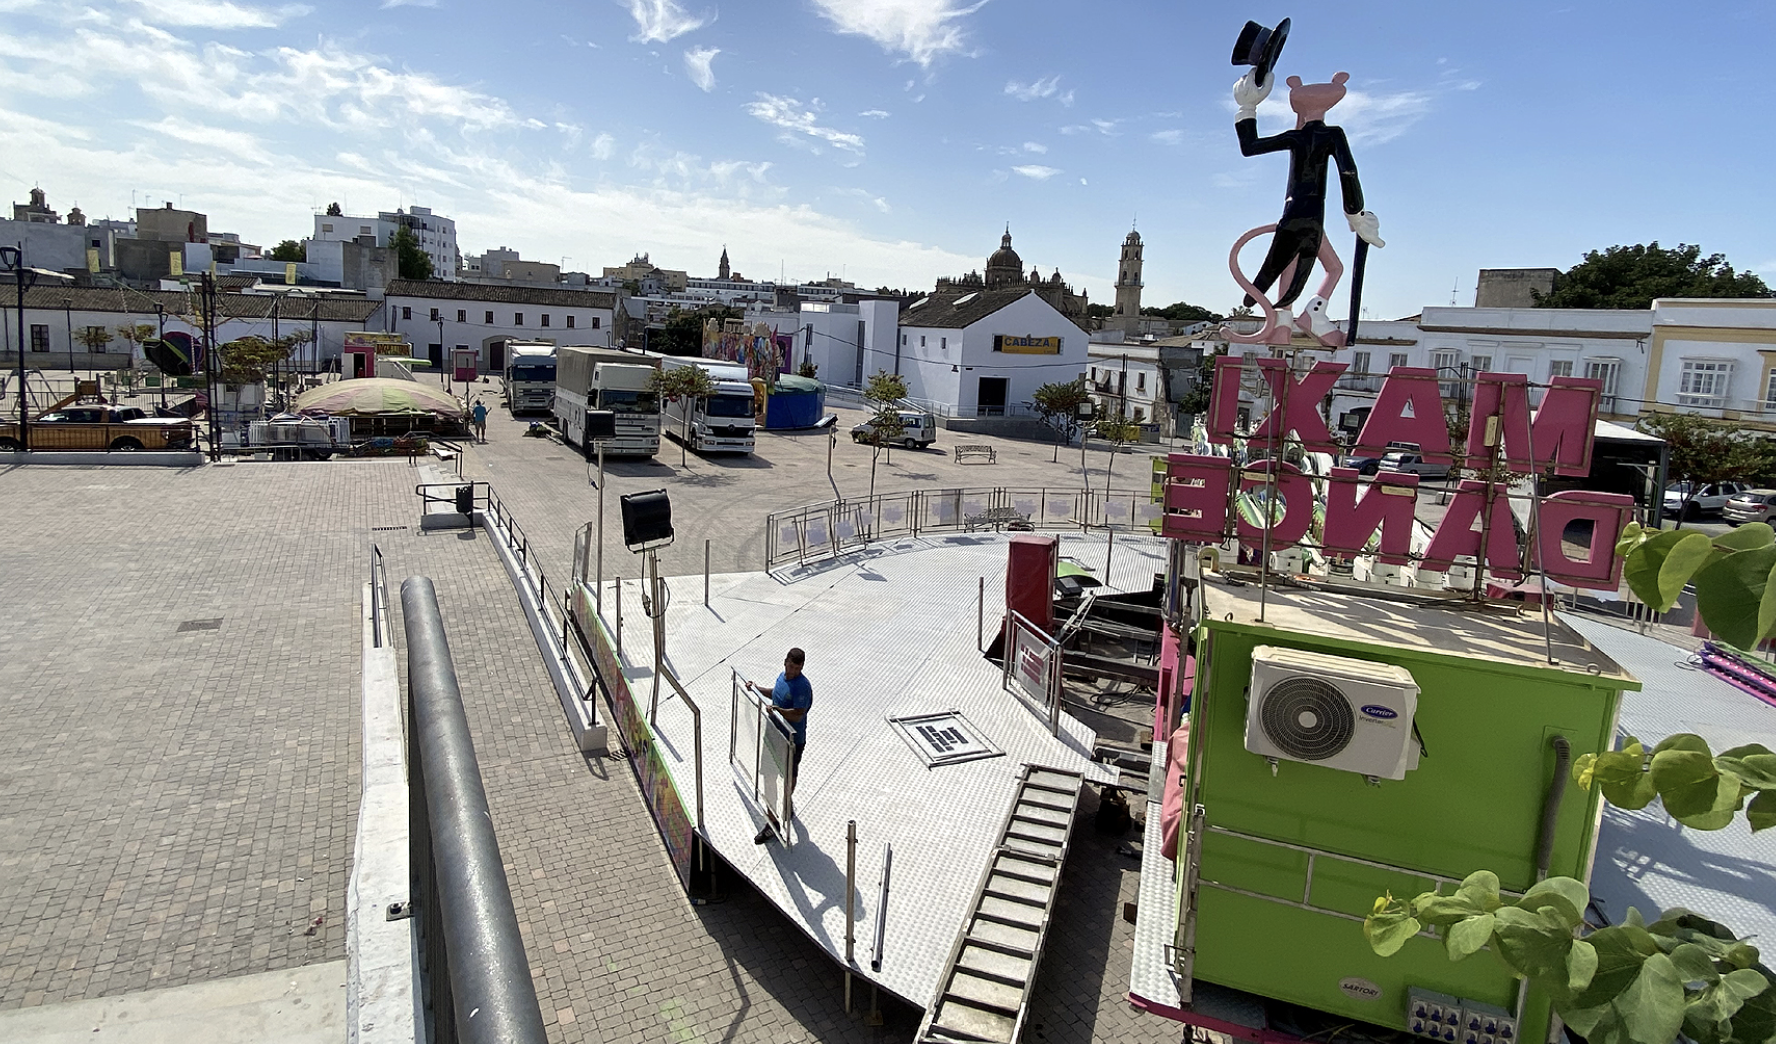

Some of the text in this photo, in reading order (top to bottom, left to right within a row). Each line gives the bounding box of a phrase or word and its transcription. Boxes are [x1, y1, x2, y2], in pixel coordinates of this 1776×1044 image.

[1004, 336, 1050, 347] CABEZA
[1365, 707, 1394, 717] Carrier
[1342, 983, 1379, 996] SARTORI
